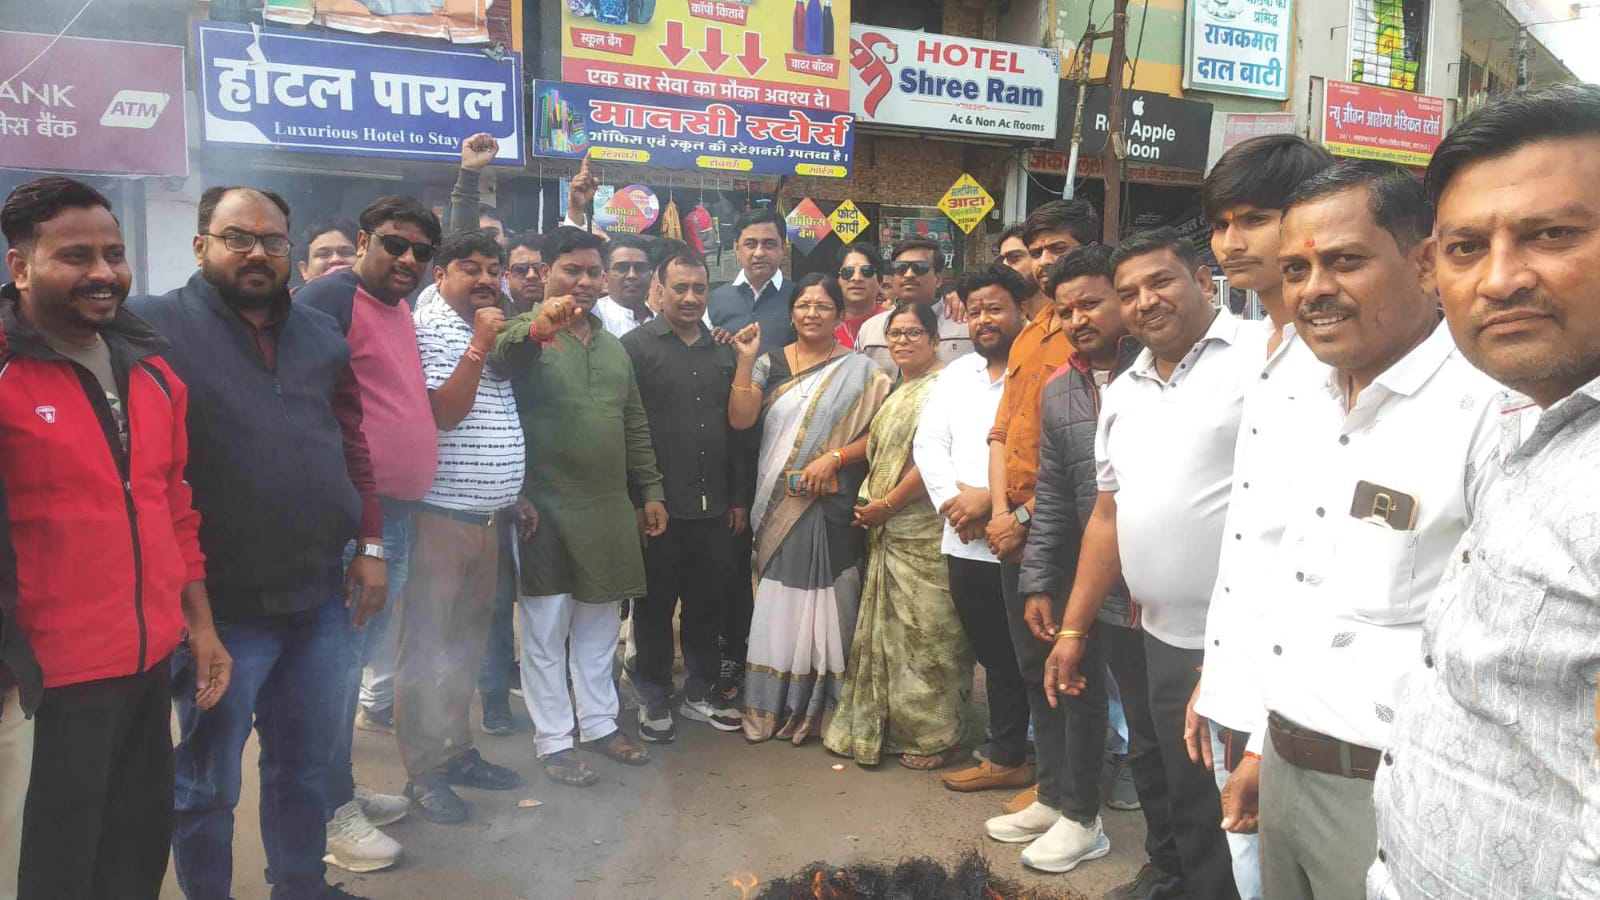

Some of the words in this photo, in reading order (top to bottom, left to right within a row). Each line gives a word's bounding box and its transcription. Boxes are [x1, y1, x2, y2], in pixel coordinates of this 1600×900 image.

[580, 33, 605, 48] स्कूल
[1204, 23, 1279, 52] राजकमल
[791, 58, 810, 71] वाटर
[917, 40, 1025, 74] HOTEL
[213, 45, 356, 113] होटल
[371, 71, 506, 122] पायल
[1197, 56, 1236, 81] दाल
[1240, 58, 1282, 87] बाटी
[586, 68, 618, 87] एक
[623, 72, 651, 91] बार
[656, 72, 688, 94] सेवा
[693, 80, 716, 97] का
[720, 79, 759, 101] मौका
[764, 89, 810, 108] अवश्य
[900, 68, 979, 100] Shree
[986, 77, 1044, 107] Ram
[110, 101, 157, 118] ATM
[1329, 105, 1342, 129] न्यू
[36, 111, 77, 138] बैंक
[274, 121, 359, 140] Luxurious
[363, 127, 404, 143] Hotel
[410, 131, 424, 145] to
[428, 131, 461, 149] Stay
[746, 110, 854, 147] स्टोर्स
[949, 113, 963, 124] Ac
[965, 114, 973, 125] &
[975, 115, 996, 127] Non
[997, 117, 1011, 129] Ac
[1013, 119, 1045, 132] Rooms
[1130, 119, 1176, 143] Apple
[589, 130, 642, 146] ऑफिस
[647, 134, 666, 148] एवं
[670, 138, 704, 153] स्कूल
[708, 138, 727, 153] की
[730, 141, 785, 158] स्टेशनरी
[1126, 139, 1160, 160] loon
[837, 206, 859, 220] फोटो
[947, 196, 986, 209] आटा
[835, 220, 859, 234] कापी
